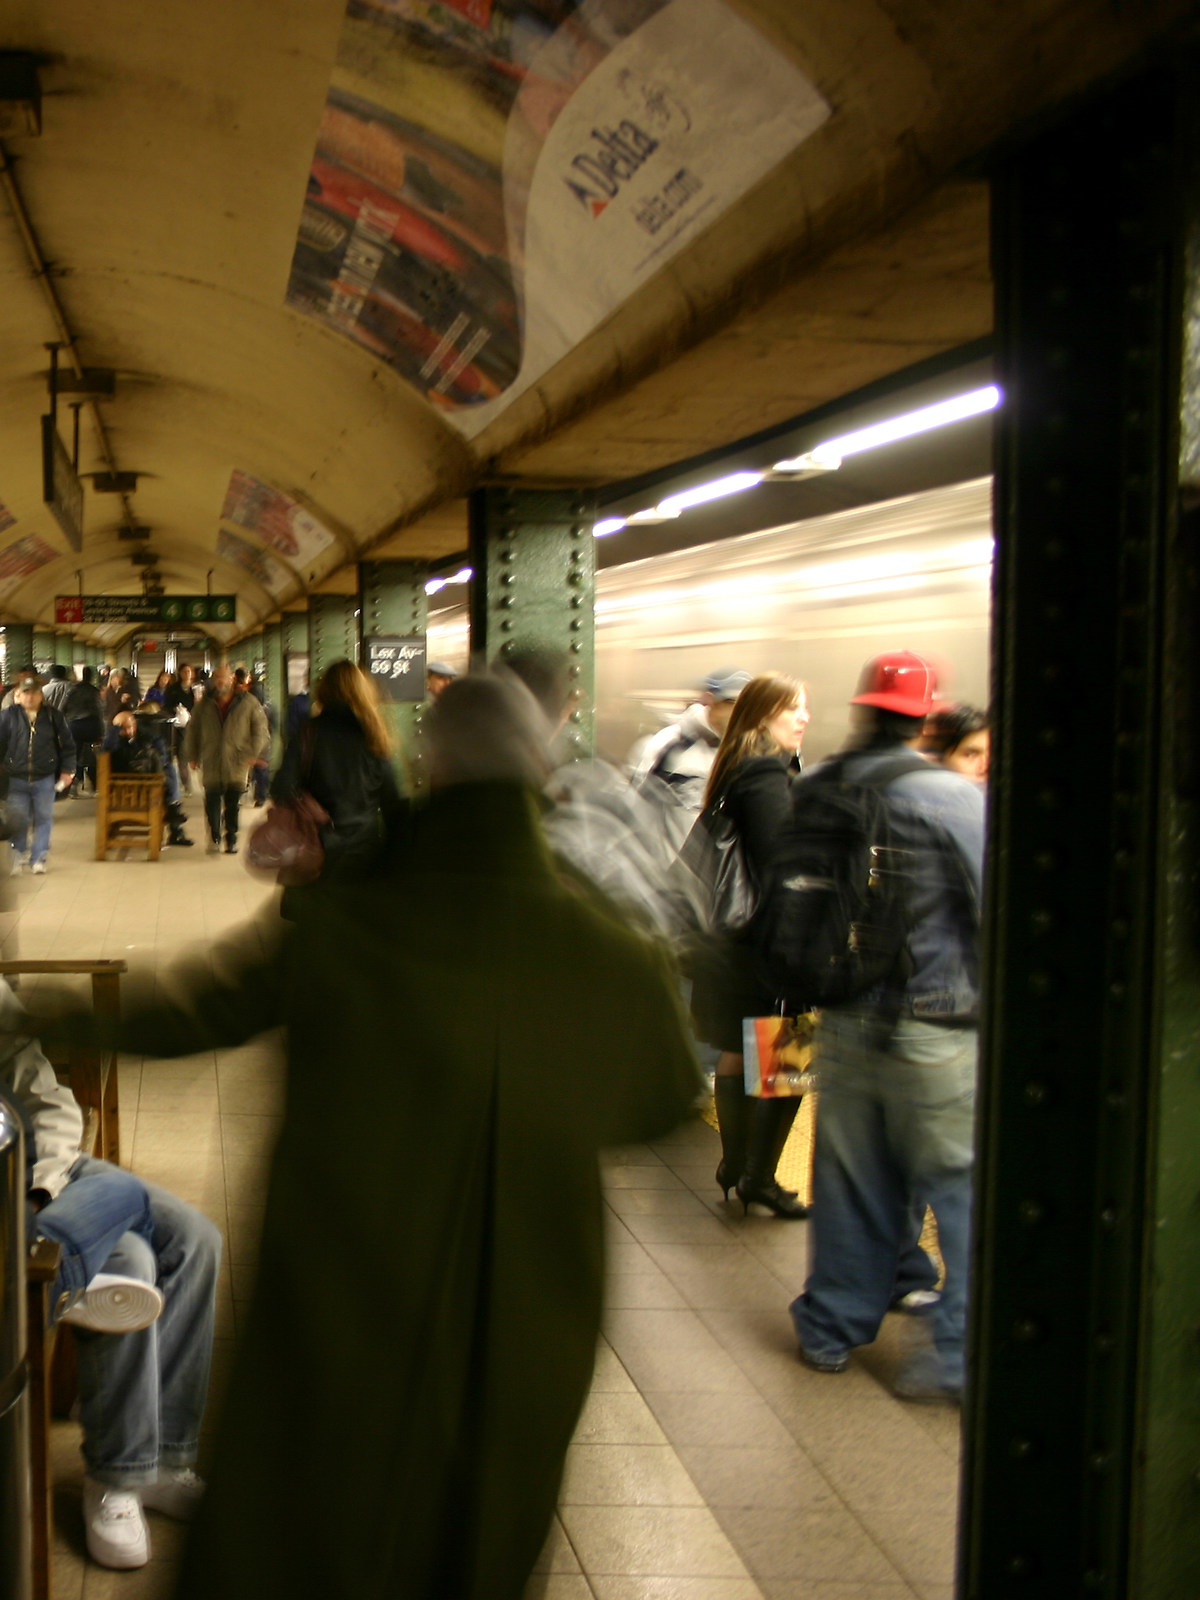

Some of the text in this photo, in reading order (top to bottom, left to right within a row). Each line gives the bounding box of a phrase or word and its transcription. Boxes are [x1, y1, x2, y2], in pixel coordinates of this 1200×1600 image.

[571, 119, 659, 198] Delta
[370, 645, 396, 659] Lex
[392, 660, 411, 675] St
